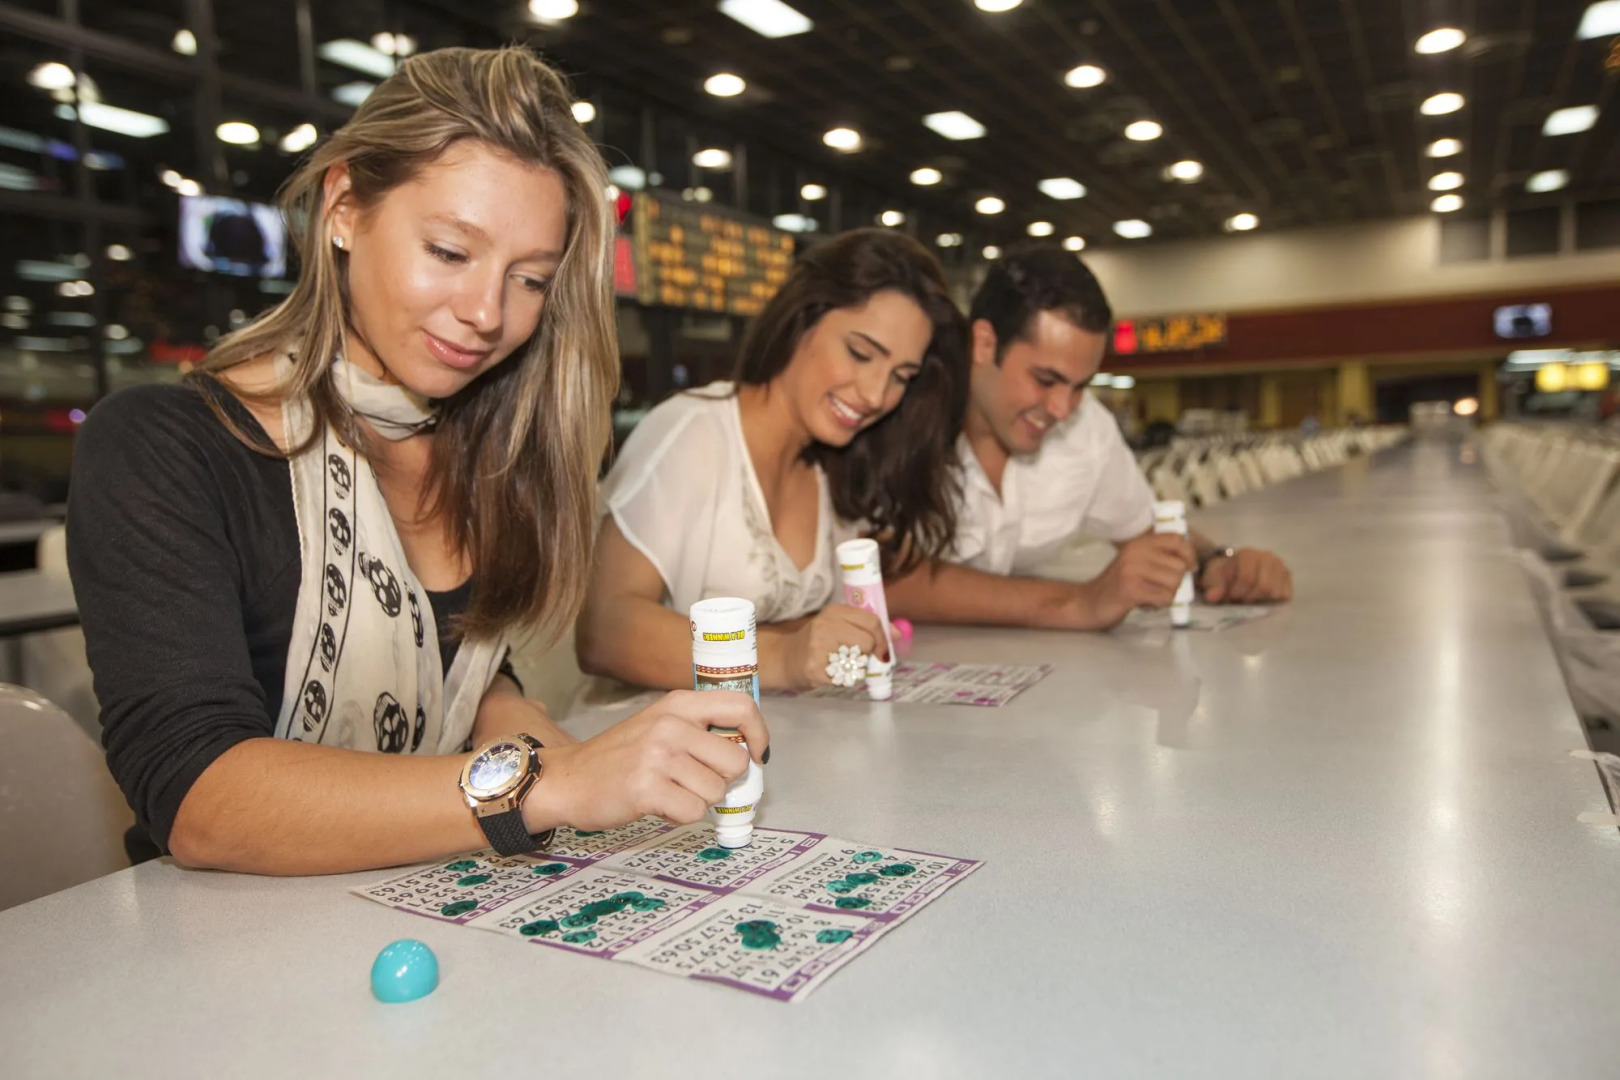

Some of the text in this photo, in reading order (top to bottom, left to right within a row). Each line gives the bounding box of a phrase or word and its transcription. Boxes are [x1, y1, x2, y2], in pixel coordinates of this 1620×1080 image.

[553, 845, 579, 855] 74
[664, 841, 684, 850] 41
[682, 844, 705, 854] 43
[571, 848, 597, 858] 72
[644, 849, 668, 858] 58
[760, 846, 783, 857] 20
[502, 858, 526, 867] 13
[624, 857, 650, 867] 72
[664, 853, 688, 863] 53
[743, 855, 767, 864] 35
[820, 856, 844, 867] 20
[903, 858, 925, 866] 12
[645, 861, 670, 872] 75
[704, 861, 727, 872] 48
[725, 864, 749, 875] 50
[843, 859, 867, 870] 23
[926, 861, 948, 869] 10
[420, 868, 447, 879] 34
[497, 871, 523, 880] 30
[668, 866, 688, 878] 67
[804, 866, 828, 875] 33
[911, 869, 935, 879] 26
[437, 872, 462, 883] 40
[516, 873, 541, 883] 21
[685, 871, 709, 882] 63
[706, 874, 730, 885] 66
[788, 875, 810, 884] 51
[396, 878, 421, 888] 51
[414, 882, 439, 894] 59
[473, 879, 498, 890] 43
[492, 883, 519, 893] 36
[613, 878, 636, 887] 11
[896, 879, 921, 889] 36
[369, 887, 396, 897] 63
[430, 887, 457, 898] 52
[590, 887, 617, 898] 26
[654, 888, 678, 898] 14
[769, 884, 793, 895] 65
[792, 888, 816, 900] 64
[387, 892, 413, 903] 68
[451, 890, 475, 902] 49
[674, 893, 699, 901] 12
[406, 897, 433, 907] 71
[499, 875, 616, 929] 13 21 36 57 63
[738, 903, 763, 914] 13
[548, 909, 570, 923] 47
[609, 909, 638, 921] 32
[631, 912, 657, 924] 45
[718, 914, 744, 925] 21
[785, 915, 809, 923] 10
[610, 925, 634, 936] 51
[583, 936, 613, 948] 72
